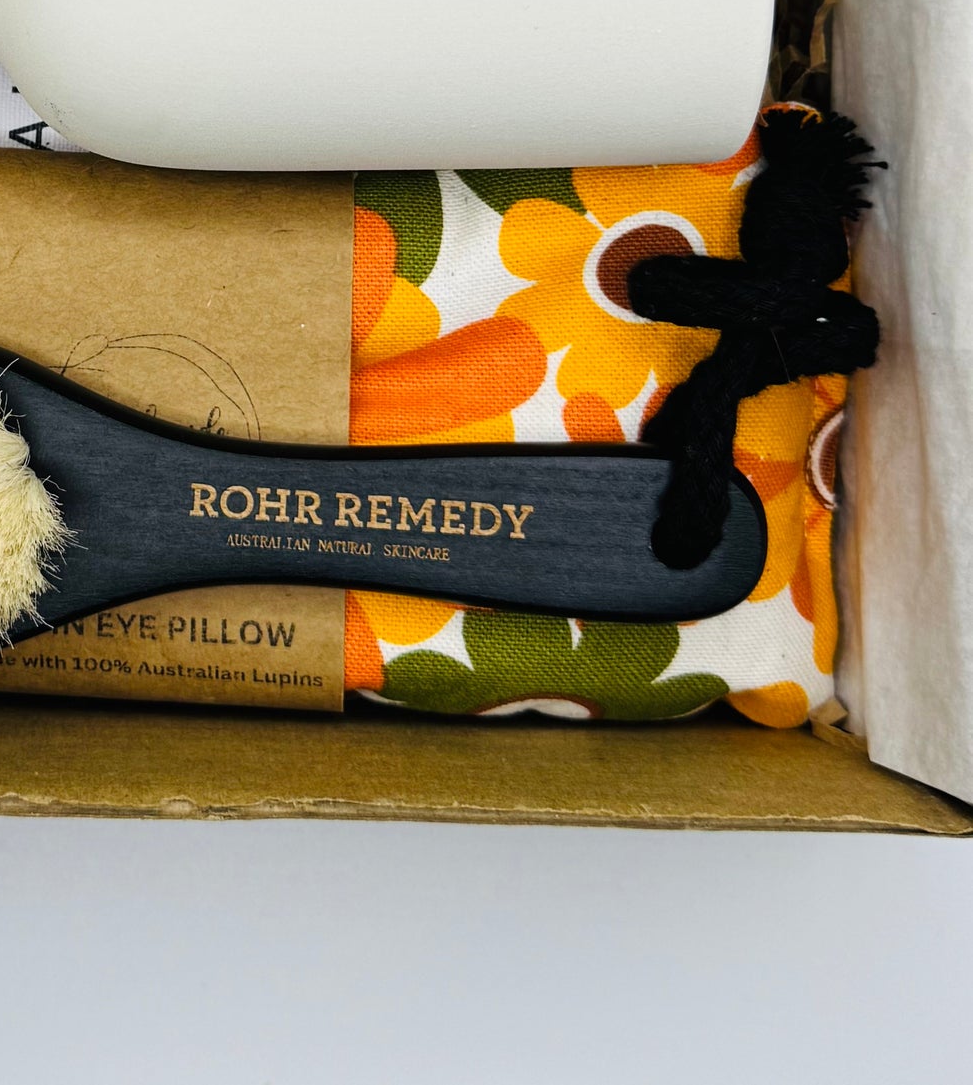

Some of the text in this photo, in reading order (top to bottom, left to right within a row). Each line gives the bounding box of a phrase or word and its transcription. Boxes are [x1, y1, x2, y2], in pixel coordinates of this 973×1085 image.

[188, 482, 535, 540] ROHR REMEDY
[227, 533, 451, 562] AUSTRALIAN NATURAL SKINCARE
[96, 612, 158, 642] EYE
[169, 616, 297, 649] PILLOW
[23, 654, 67, 671] with
[72, 656, 133, 676] 100%
[137, 661, 246, 683] Australian
[252, 667, 324, 690] Lupins
